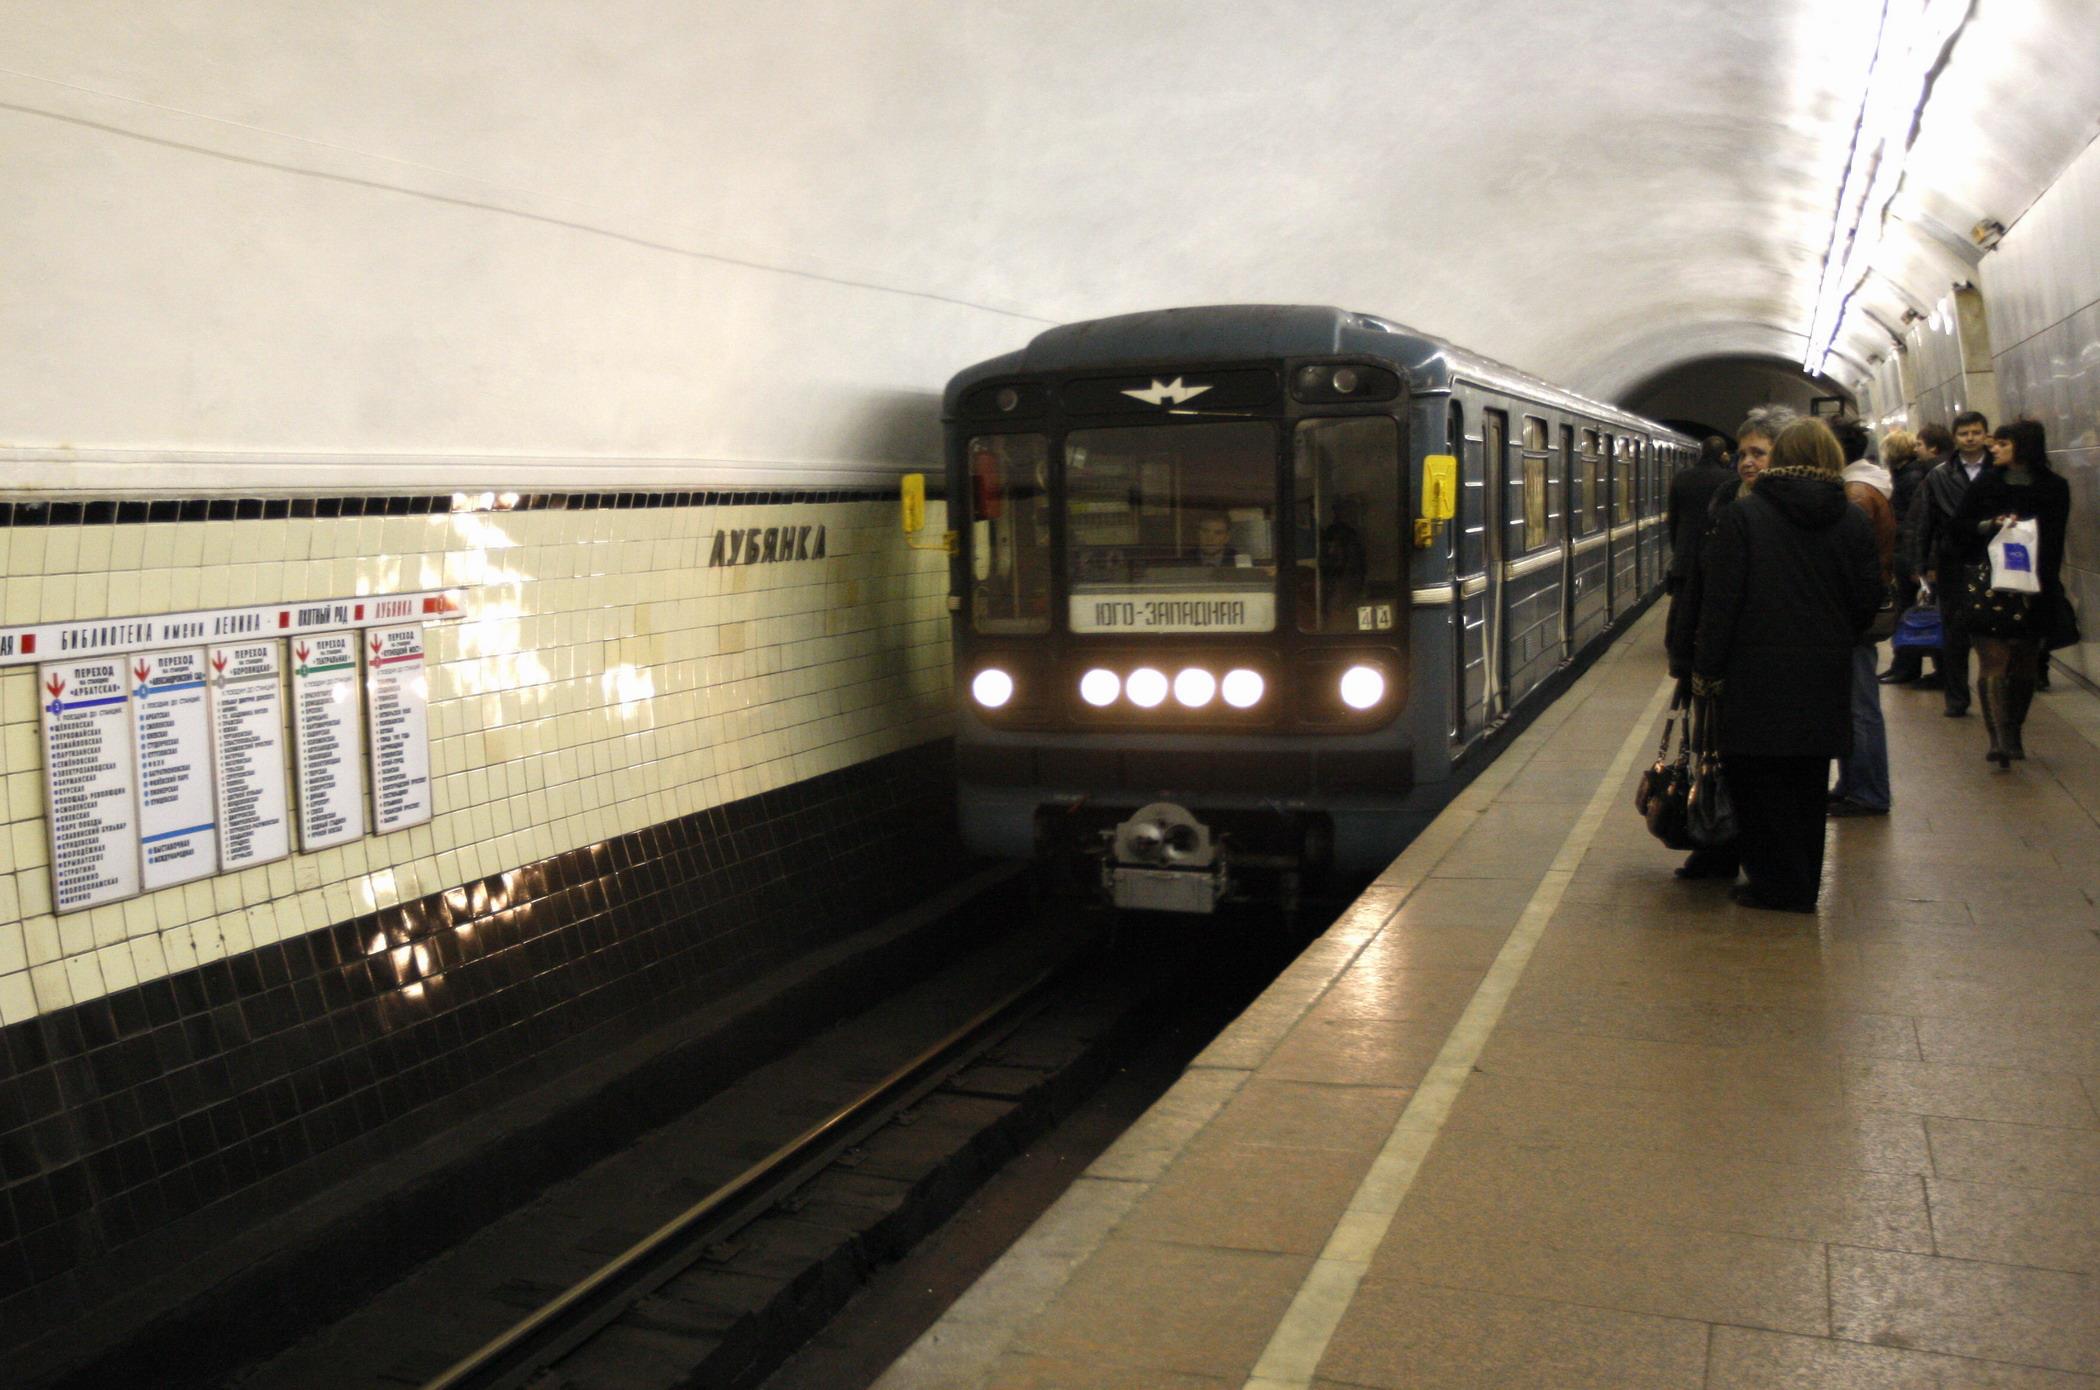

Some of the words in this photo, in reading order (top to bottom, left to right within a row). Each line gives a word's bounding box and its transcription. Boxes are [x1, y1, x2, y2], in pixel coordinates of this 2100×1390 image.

[708, 523, 826, 568] ЛУБЯНКА
[297, 604, 331, 627] ОХОТНЫЙ
[333, 605, 348, 625] РЯД
[375, 600, 412, 619] ЛУБЯНКА
[1095, 601, 1245, 627] ЮГО-ЗАПАДНАЯ
[61, 623, 153, 651] БИБЛИОТЕКА
[214, 613, 260, 636] ЛЕНИНА
[388, 631, 414, 642] ПЕРЕХОД
[316, 639, 345, 650] ПЕРЕХОД
[235, 647, 267, 659] ПЕРЕХОД
[158, 655, 194, 667] ПЕРЕХОД
[74, 666, 114, 678] ПЕРЕХОД
